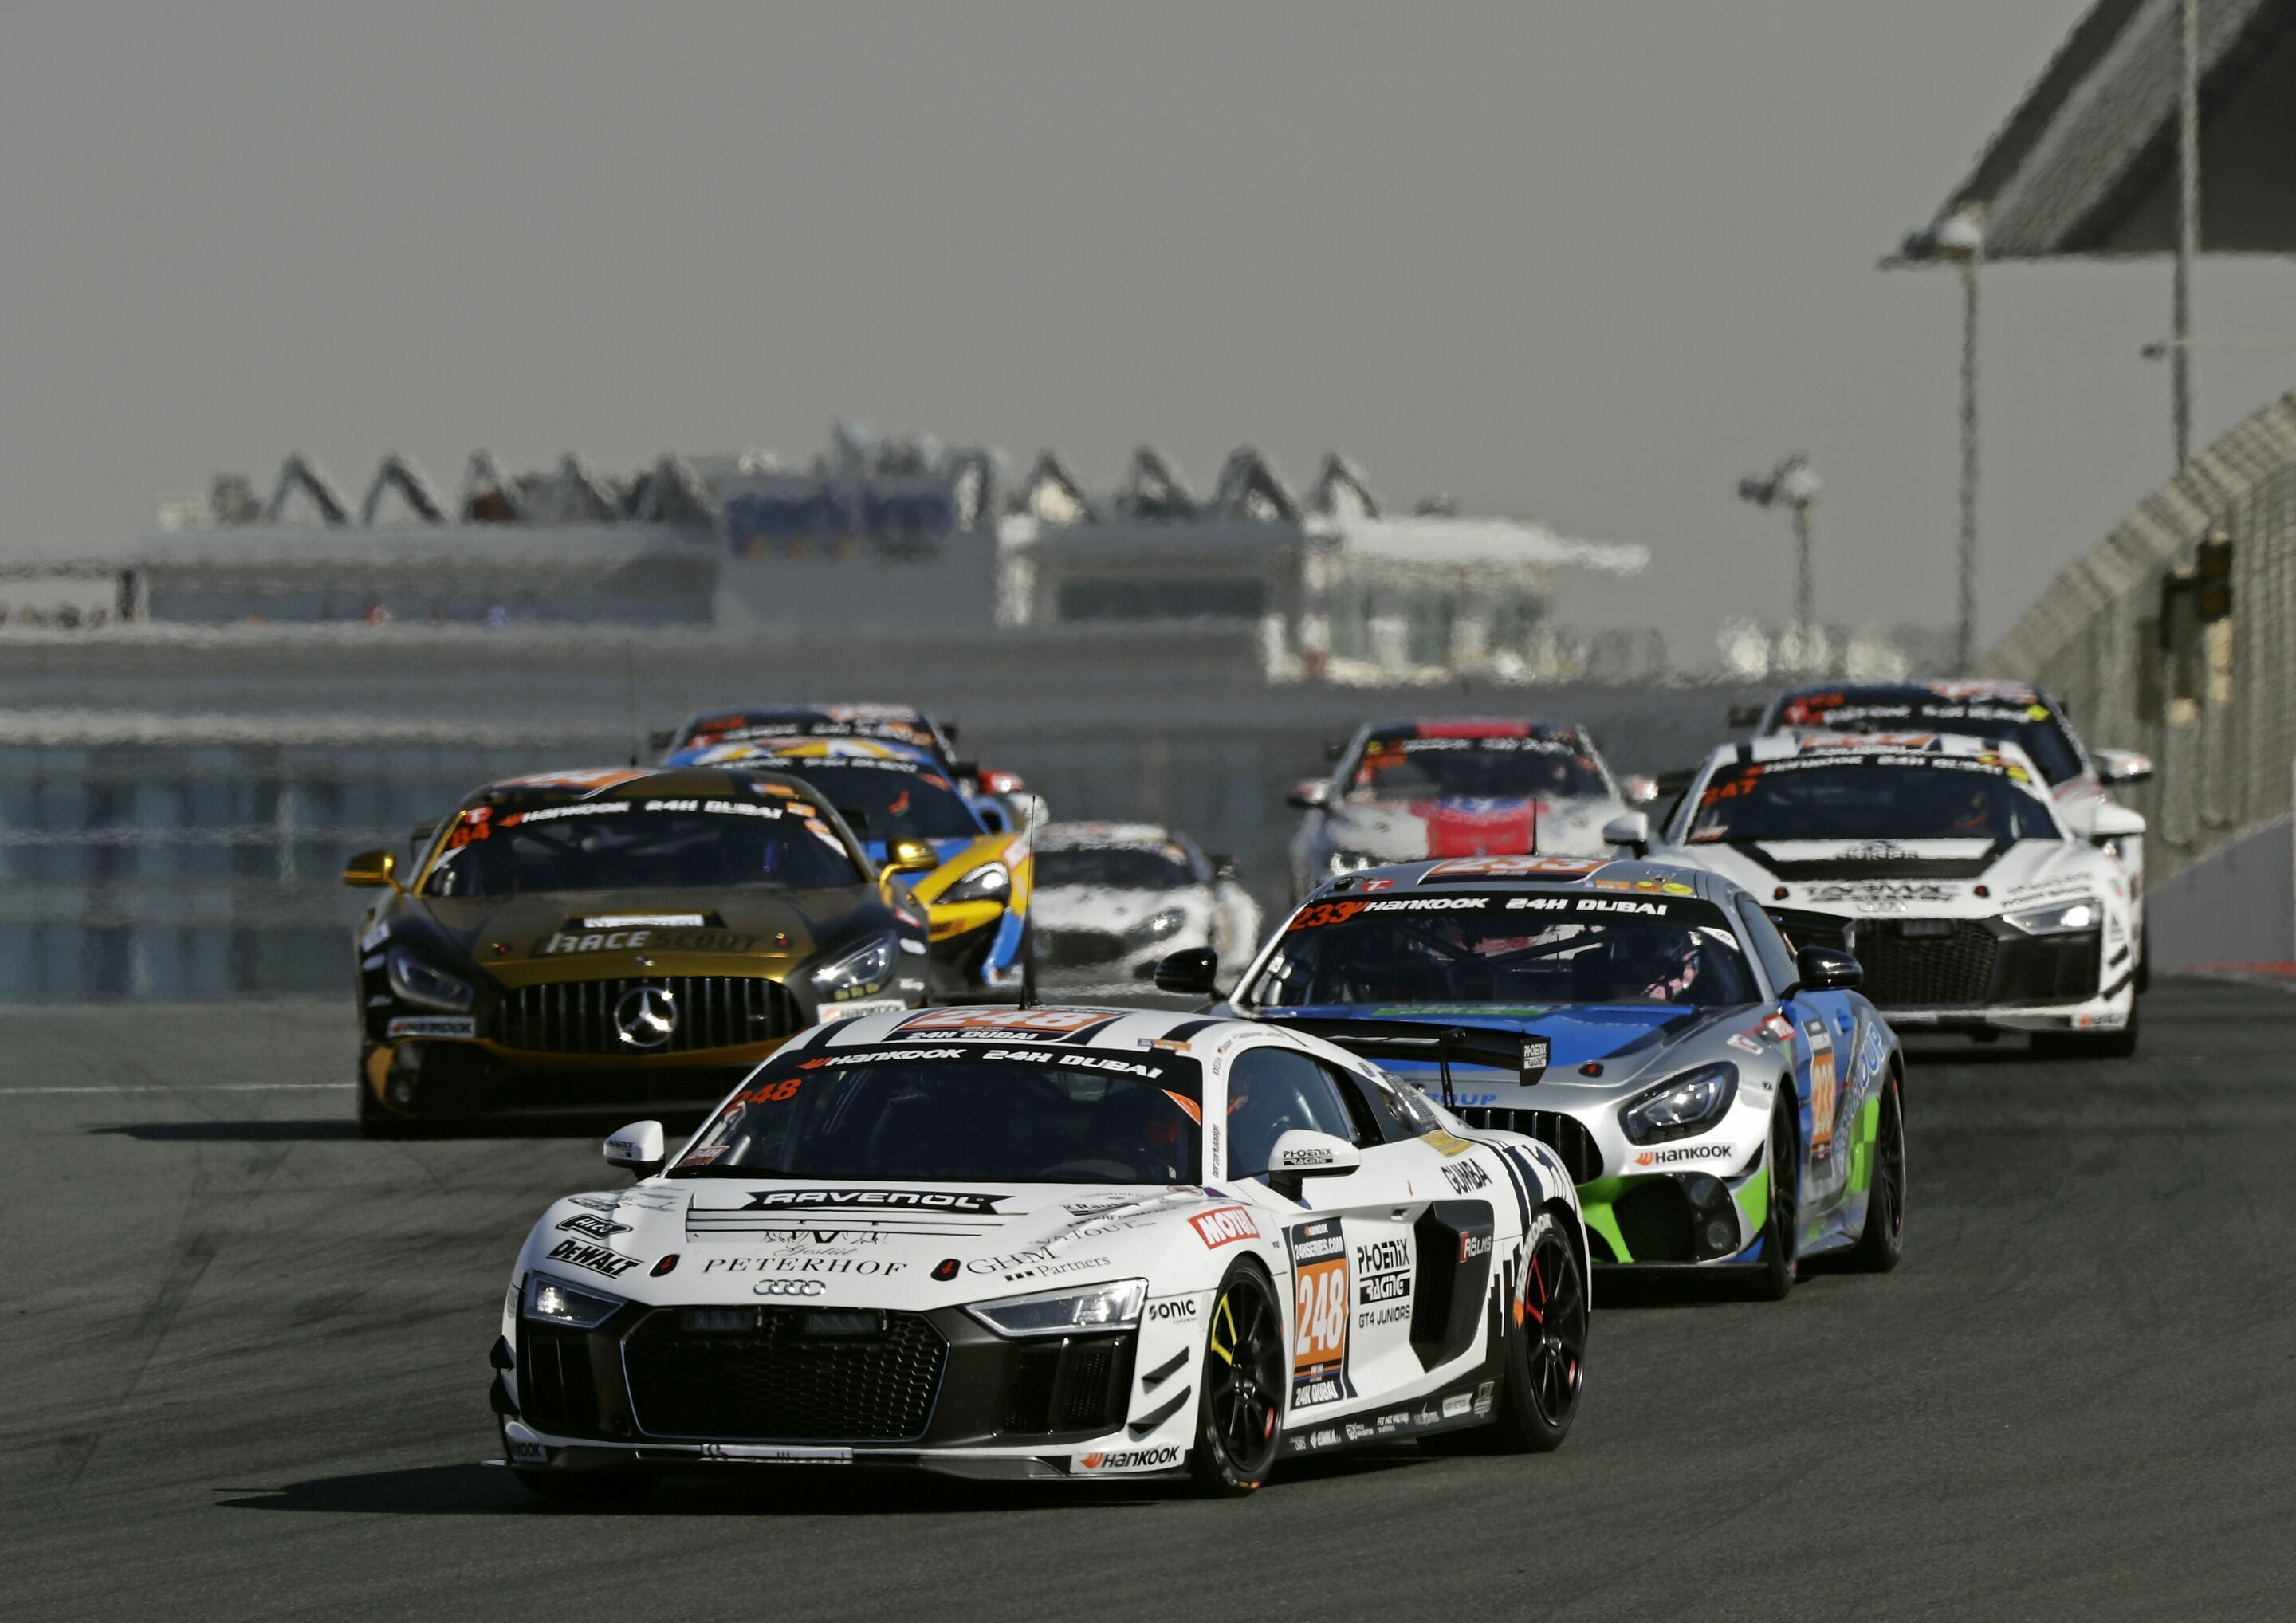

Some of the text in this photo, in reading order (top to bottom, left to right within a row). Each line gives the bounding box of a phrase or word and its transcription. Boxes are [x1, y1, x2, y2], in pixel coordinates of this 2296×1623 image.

[1287, 901, 1353, 931] 233
[1505, 898, 1568, 910] 24H
[1576, 898, 1669, 916] DUBAI
[912, 1010, 1099, 1028] 248
[905, 1030, 1040, 1040] 24H DUBAI
[982, 1049, 1055, 1063] 24H
[1058, 1055, 1165, 1079] DUBAI
[721, 1079, 803, 1116] 248
[1282, 1148, 1333, 1158] PHOENIX
[1441, 1158, 1493, 1196] GUMBA
[763, 1193, 985, 1209] RAVENOL
[574, 1217, 613, 1234] HICO
[1197, 1209, 1258, 1245] MOTUL
[548, 1240, 639, 1278] DEWALT
[702, 1257, 908, 1277] PETERHOF
[965, 1245, 1062, 1276] GHM
[1036, 1253, 1113, 1278] Partners
[1356, 1237, 1411, 1275] PHOENIX
[1296, 1267, 1345, 1356] 248
[1358, 1304, 1411, 1330] GT4 JUNIORS
[1295, 1379, 1339, 1408] 24H DUBAI
